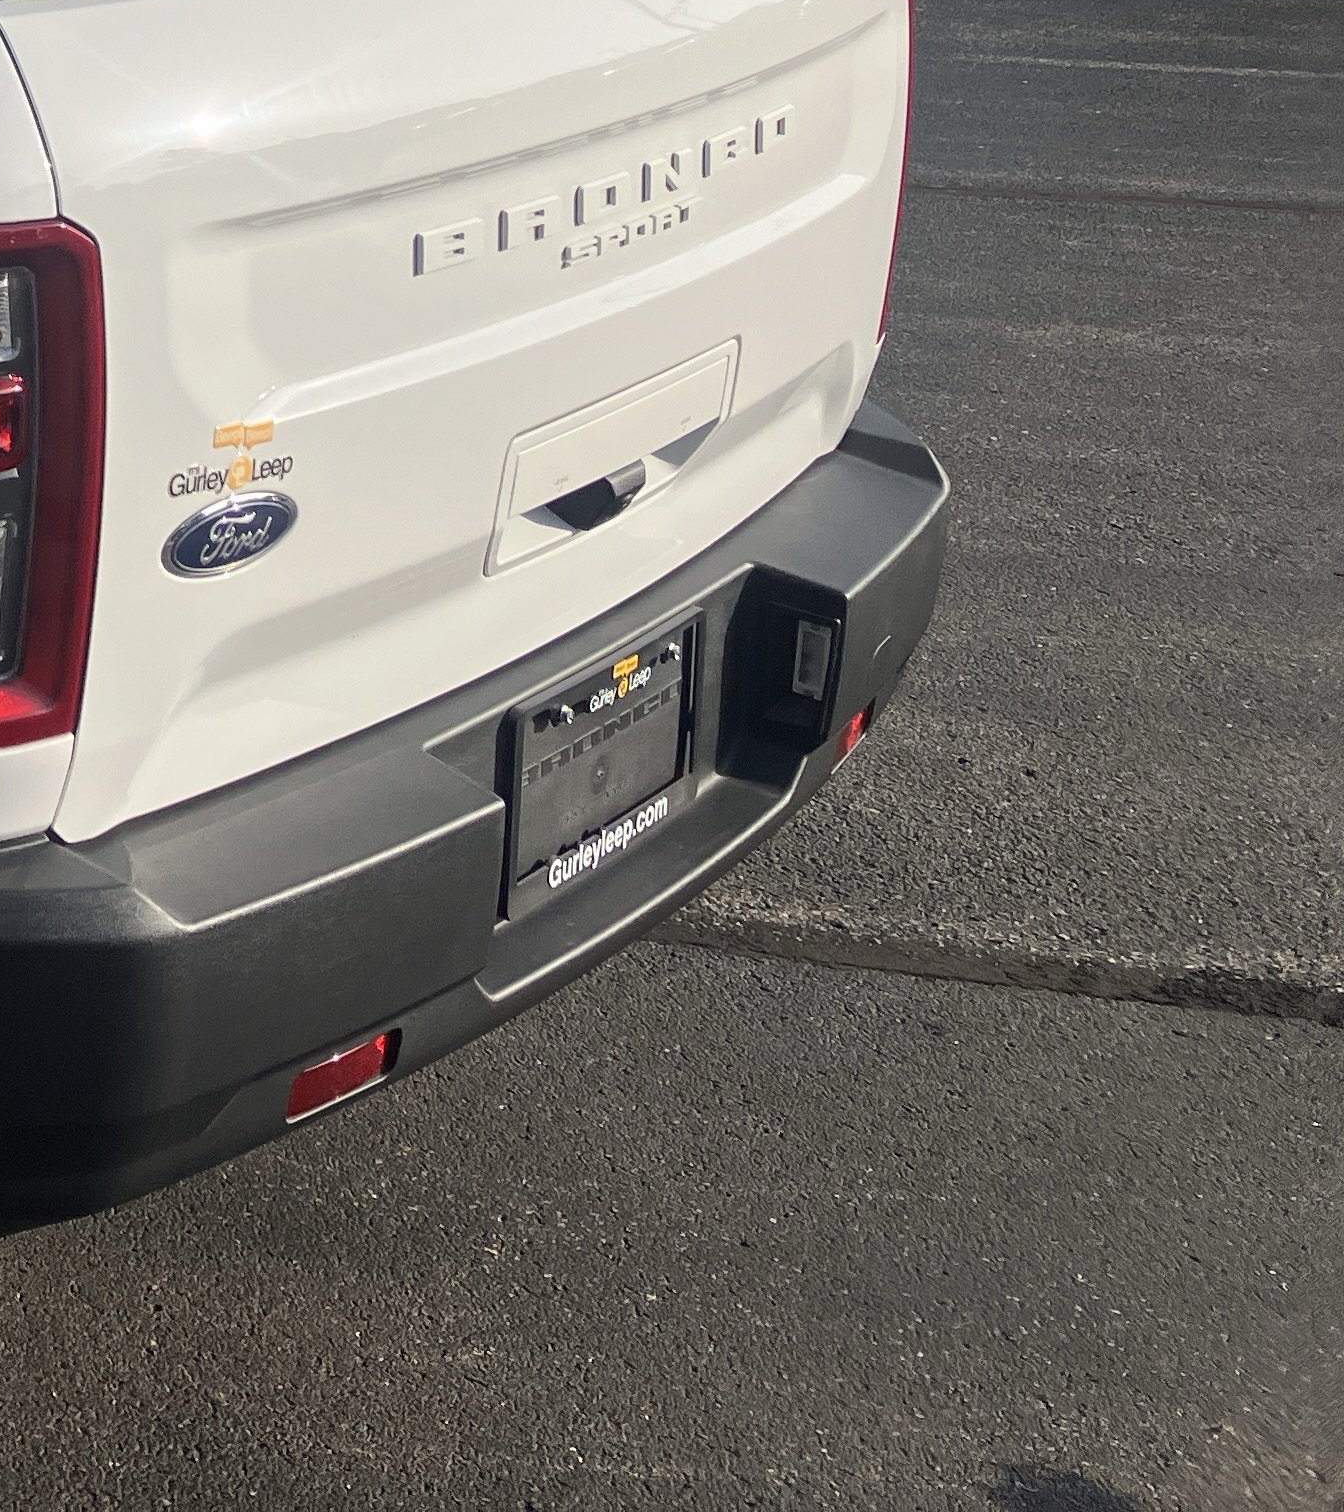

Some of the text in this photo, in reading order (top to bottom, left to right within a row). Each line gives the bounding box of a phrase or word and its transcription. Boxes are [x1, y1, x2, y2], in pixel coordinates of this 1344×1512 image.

[412, 103, 795, 277] BRONCO
[559, 195, 704, 270] SPORT
[169, 465, 229, 497] Gurley
[251, 455, 294, 482] Leep
[200, 511, 273, 566] Ford
[628, 666, 652, 691] Leep
[548, 795, 669, 889] Gurleyleep.com
